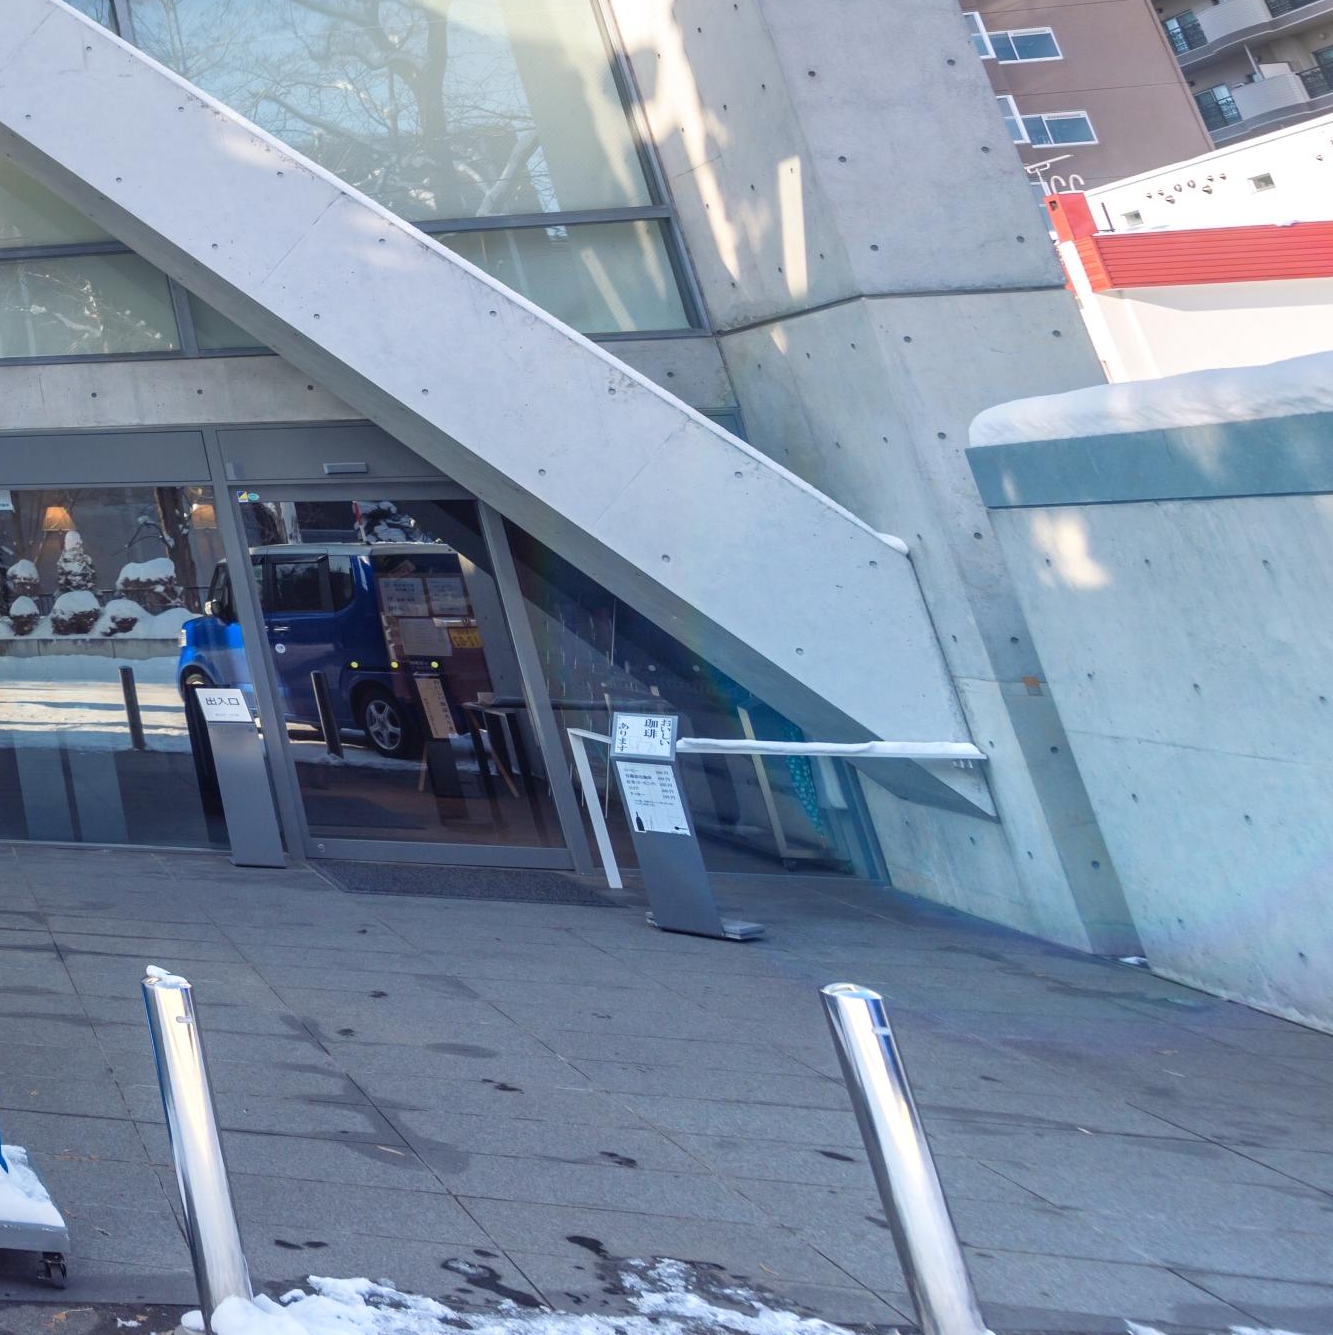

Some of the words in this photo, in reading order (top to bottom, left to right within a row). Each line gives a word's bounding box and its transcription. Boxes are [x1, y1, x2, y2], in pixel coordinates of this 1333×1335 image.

[205, 697, 240, 706] 出入口
[617, 722, 629, 752] あります
[643, 718, 658, 739] 珈琲
[659, 718, 671, 746] おいしい
